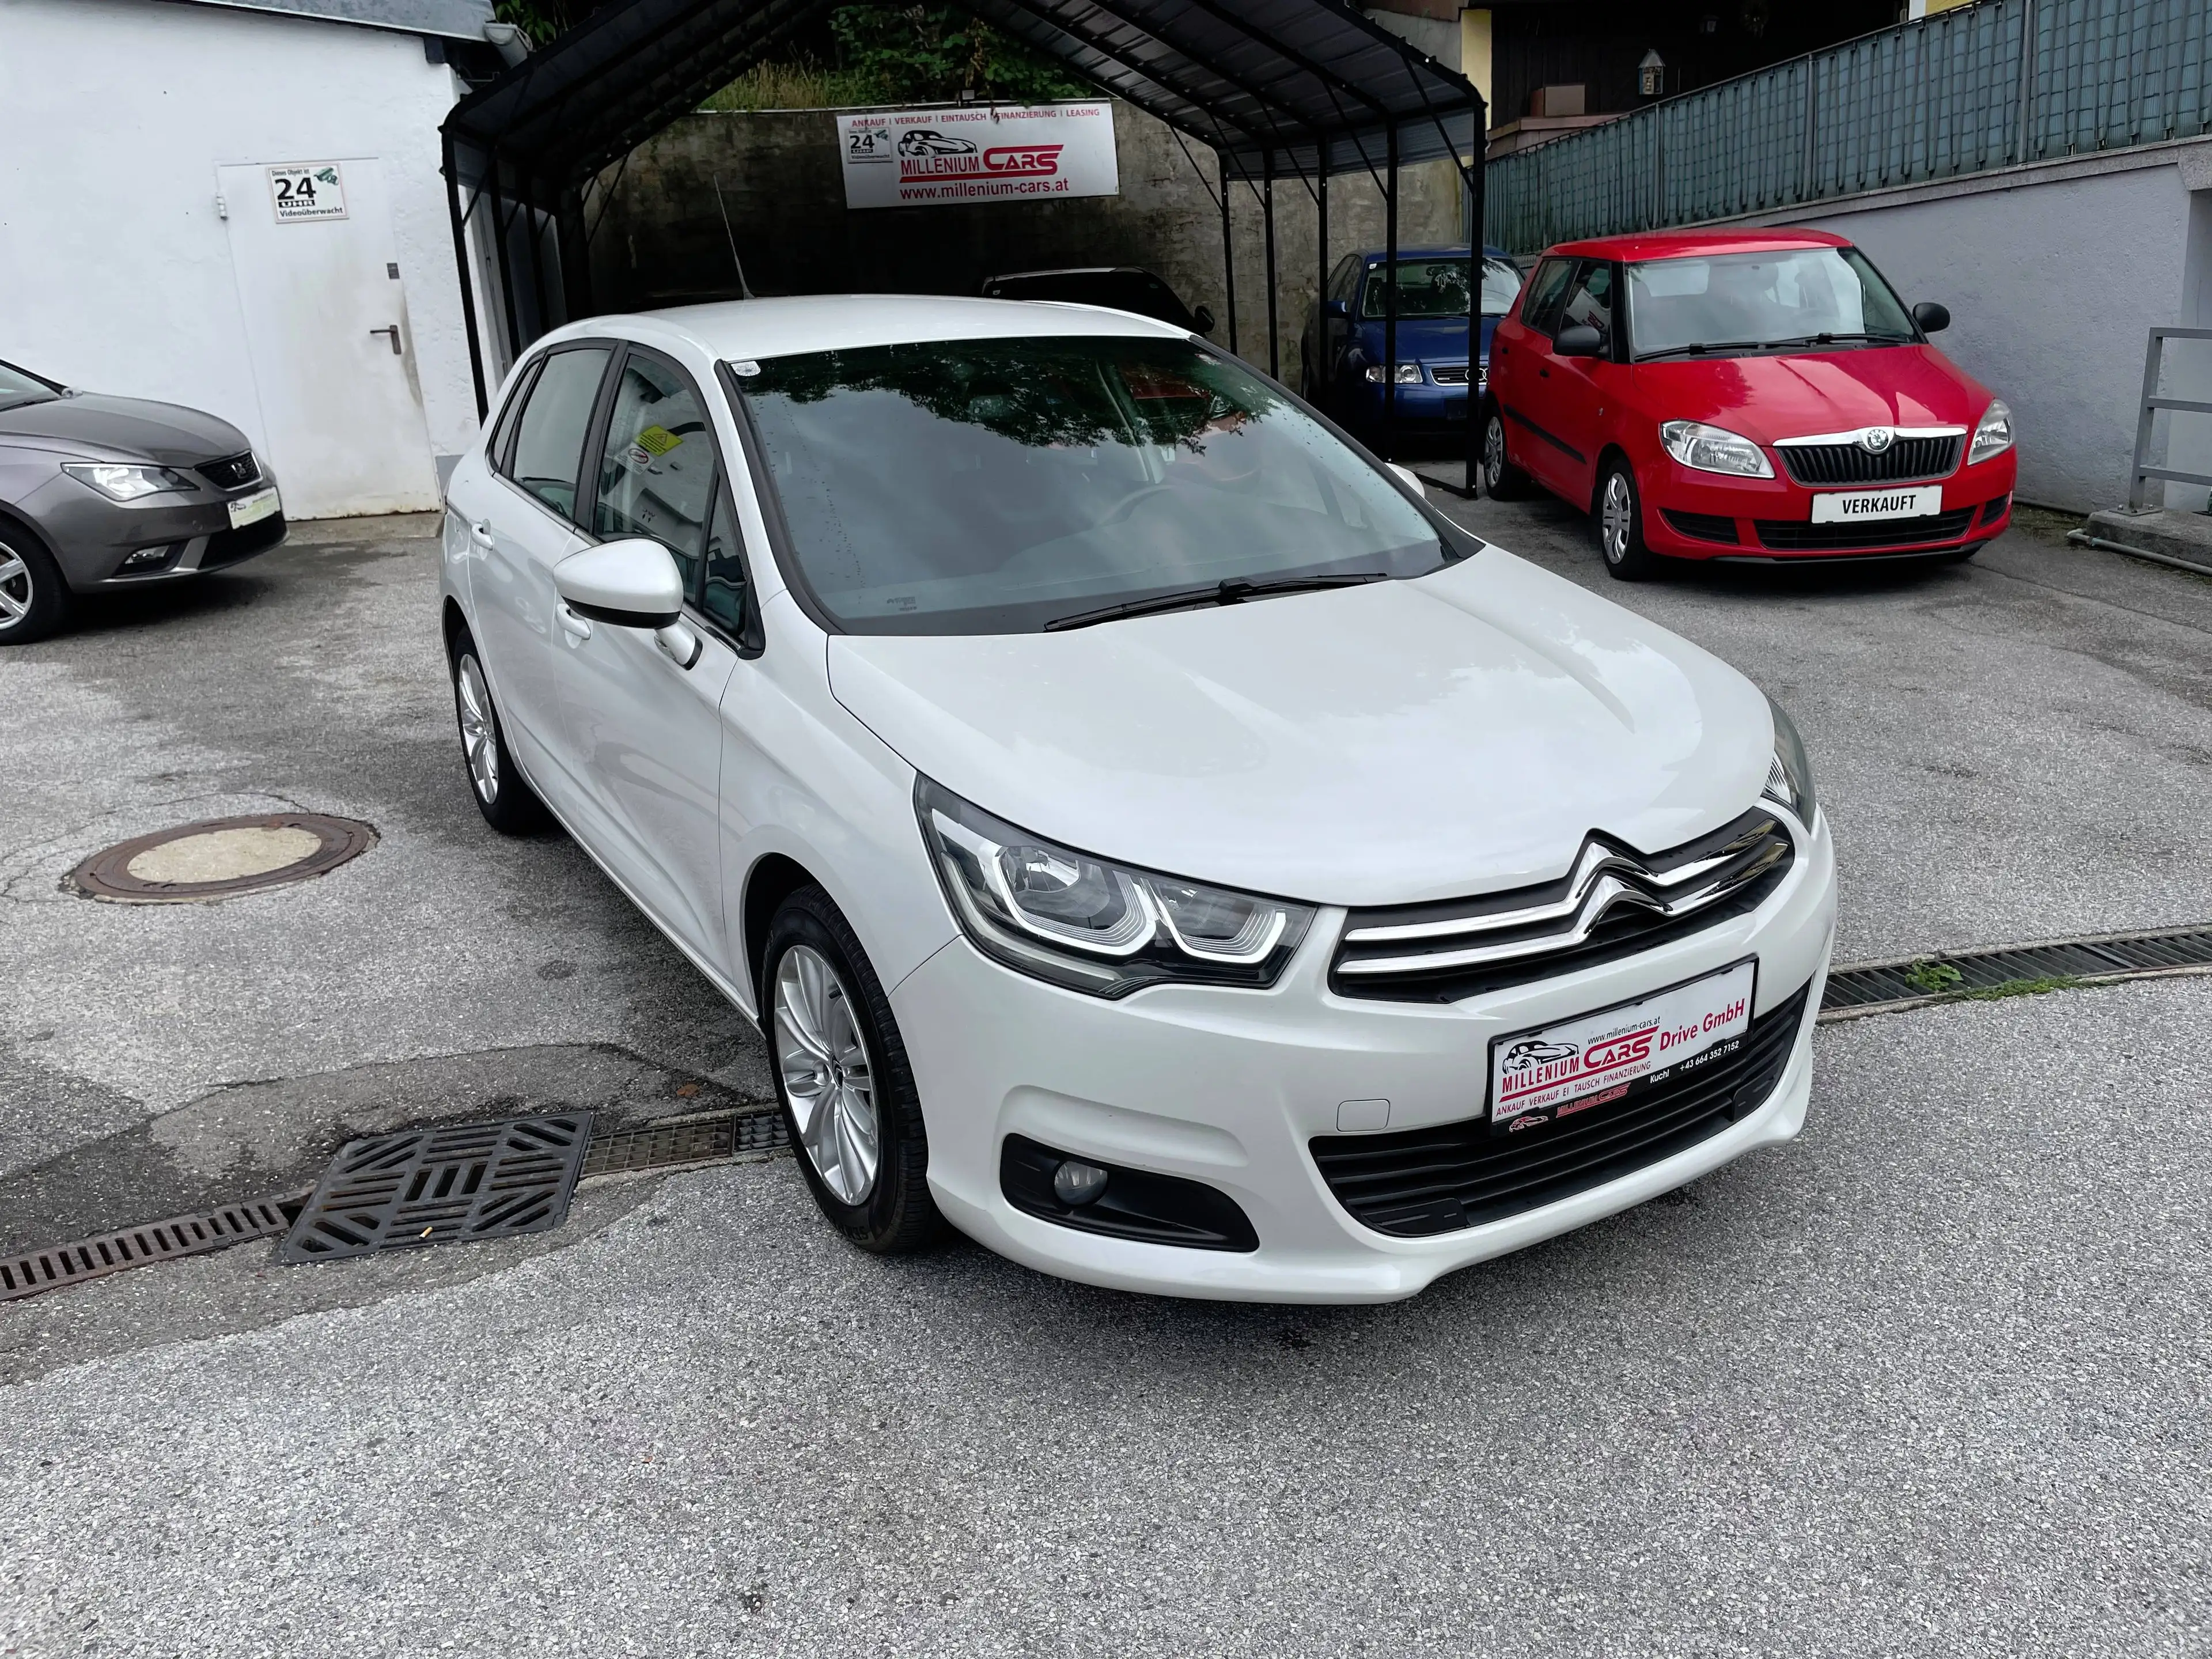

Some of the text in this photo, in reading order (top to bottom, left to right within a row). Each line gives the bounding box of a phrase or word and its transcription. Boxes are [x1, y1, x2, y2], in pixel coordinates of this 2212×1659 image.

[852, 109, 1100, 127] ANKAUF VERKAUF EINTAUSCH FINANZIERUNG LEASING
[850, 135, 874, 149] 24
[901, 145, 1064, 175] MILLENIUM CARS
[275, 177, 316, 199] 24
[900, 177, 1069, 199] www.millenium-cars.at
[280, 206, 343, 217] Videoüberwacht
[1842, 495, 1916, 514] VERKAUFT
[1588, 1016, 1660, 1045] www.millenium-cars.at
[1502, 998, 1745, 1093] MILLENIUM CARS Drive GmbH
[1650, 1040, 1739, 1084] Kuchl +43 664 352 7152
[1496, 1100, 1525, 1116] ANKAUF
[1529, 1090, 1559, 1106] VERKAUF
[1574, 1078, 1600, 1093] TAUSCH
[1603, 1061, 1651, 1084] FINANZIERUNG
